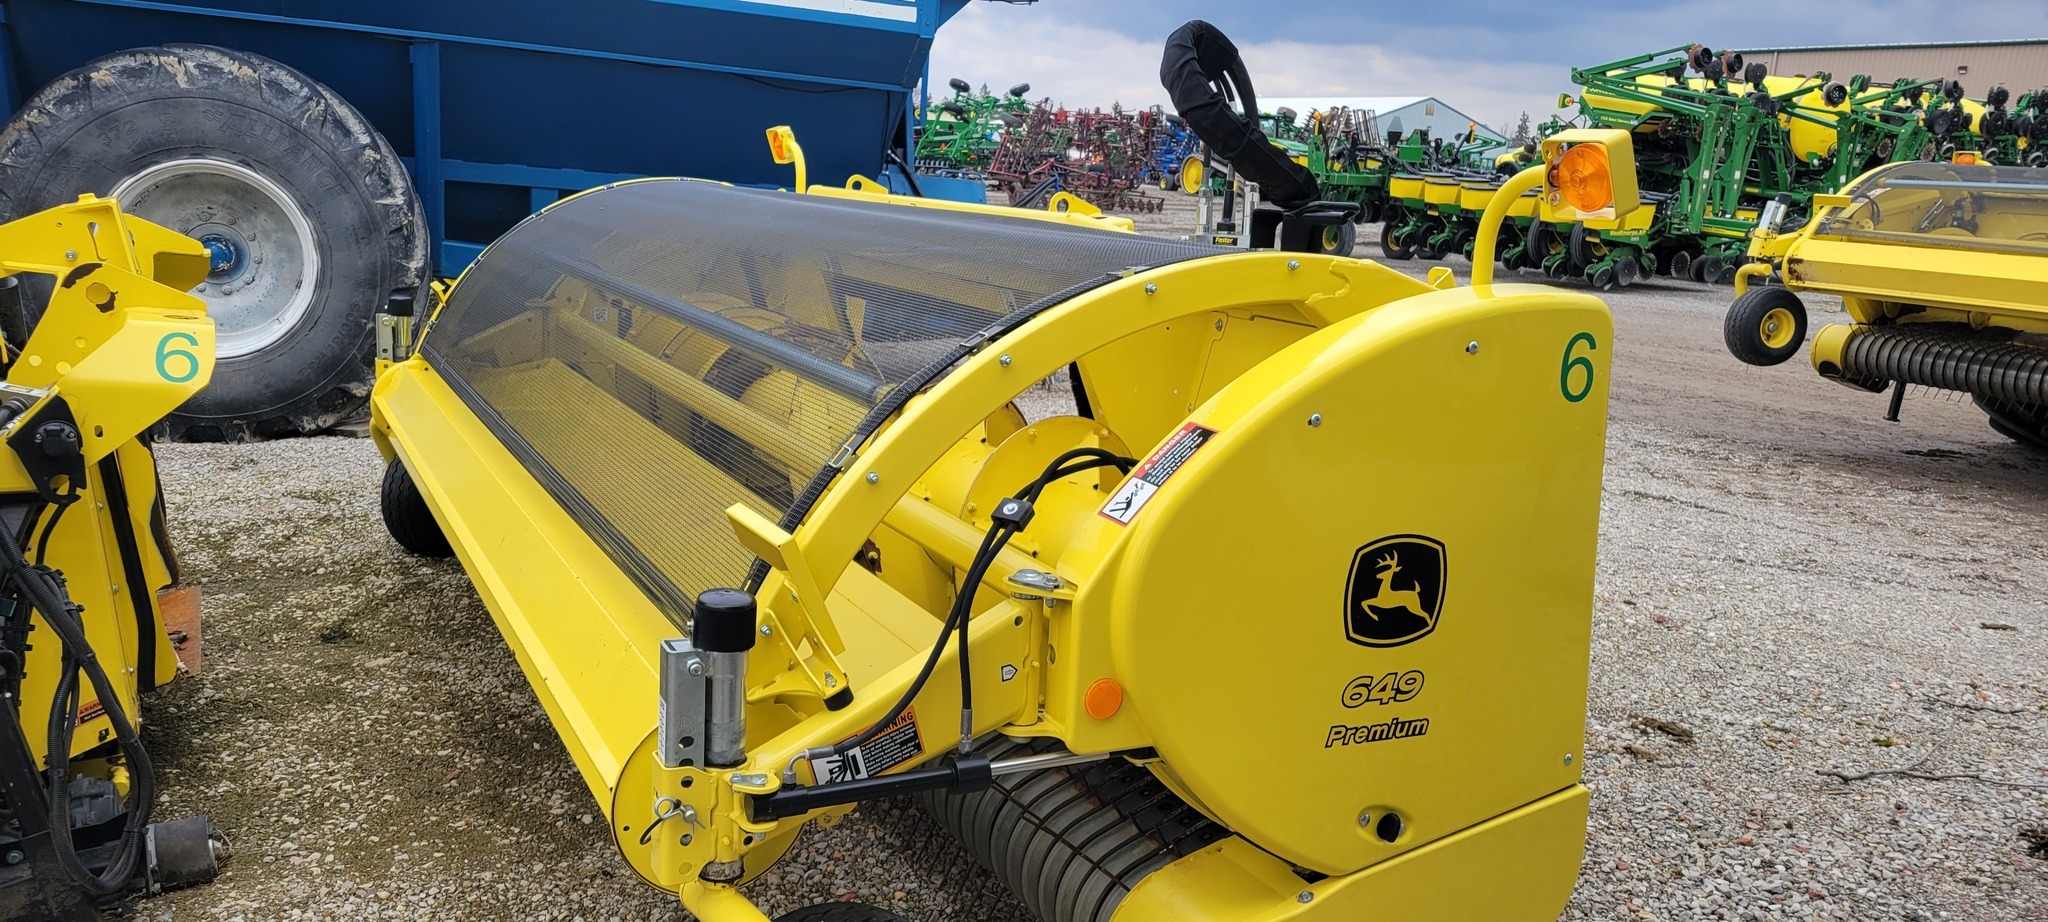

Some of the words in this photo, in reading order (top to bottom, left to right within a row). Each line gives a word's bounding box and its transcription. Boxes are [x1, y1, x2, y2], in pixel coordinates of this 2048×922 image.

[156, 332, 199, 383] 6
[1561, 332, 1596, 402] 6
[1151, 429, 1187, 461] DANGER
[1341, 670, 1425, 709] 649
[1324, 717, 1430, 749] Premium
